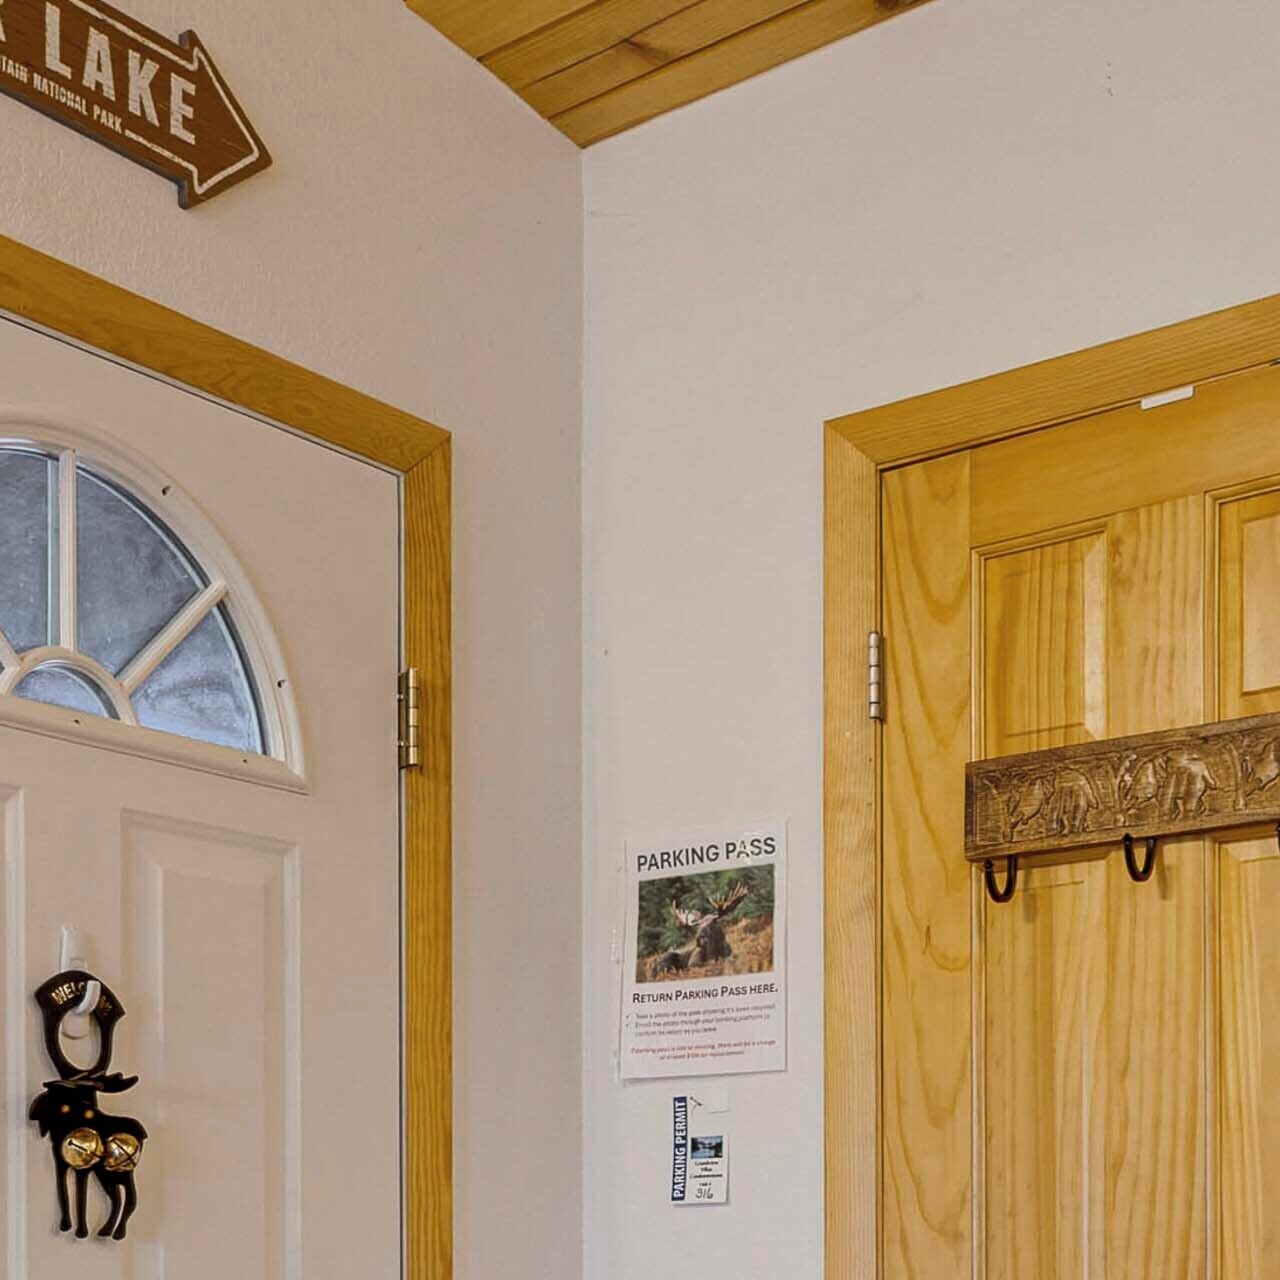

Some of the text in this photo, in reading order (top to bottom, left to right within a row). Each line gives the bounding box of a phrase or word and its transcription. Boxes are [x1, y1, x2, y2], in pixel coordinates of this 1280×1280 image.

[33, 73, 88, 116] NATIONAL
[93, 104, 122, 134] PARK
[45, 2, 196, 145] LAKE
[637, 837, 776, 872] PARKING PASS
[673, 1101, 687, 1198] PARKING PERMIT
